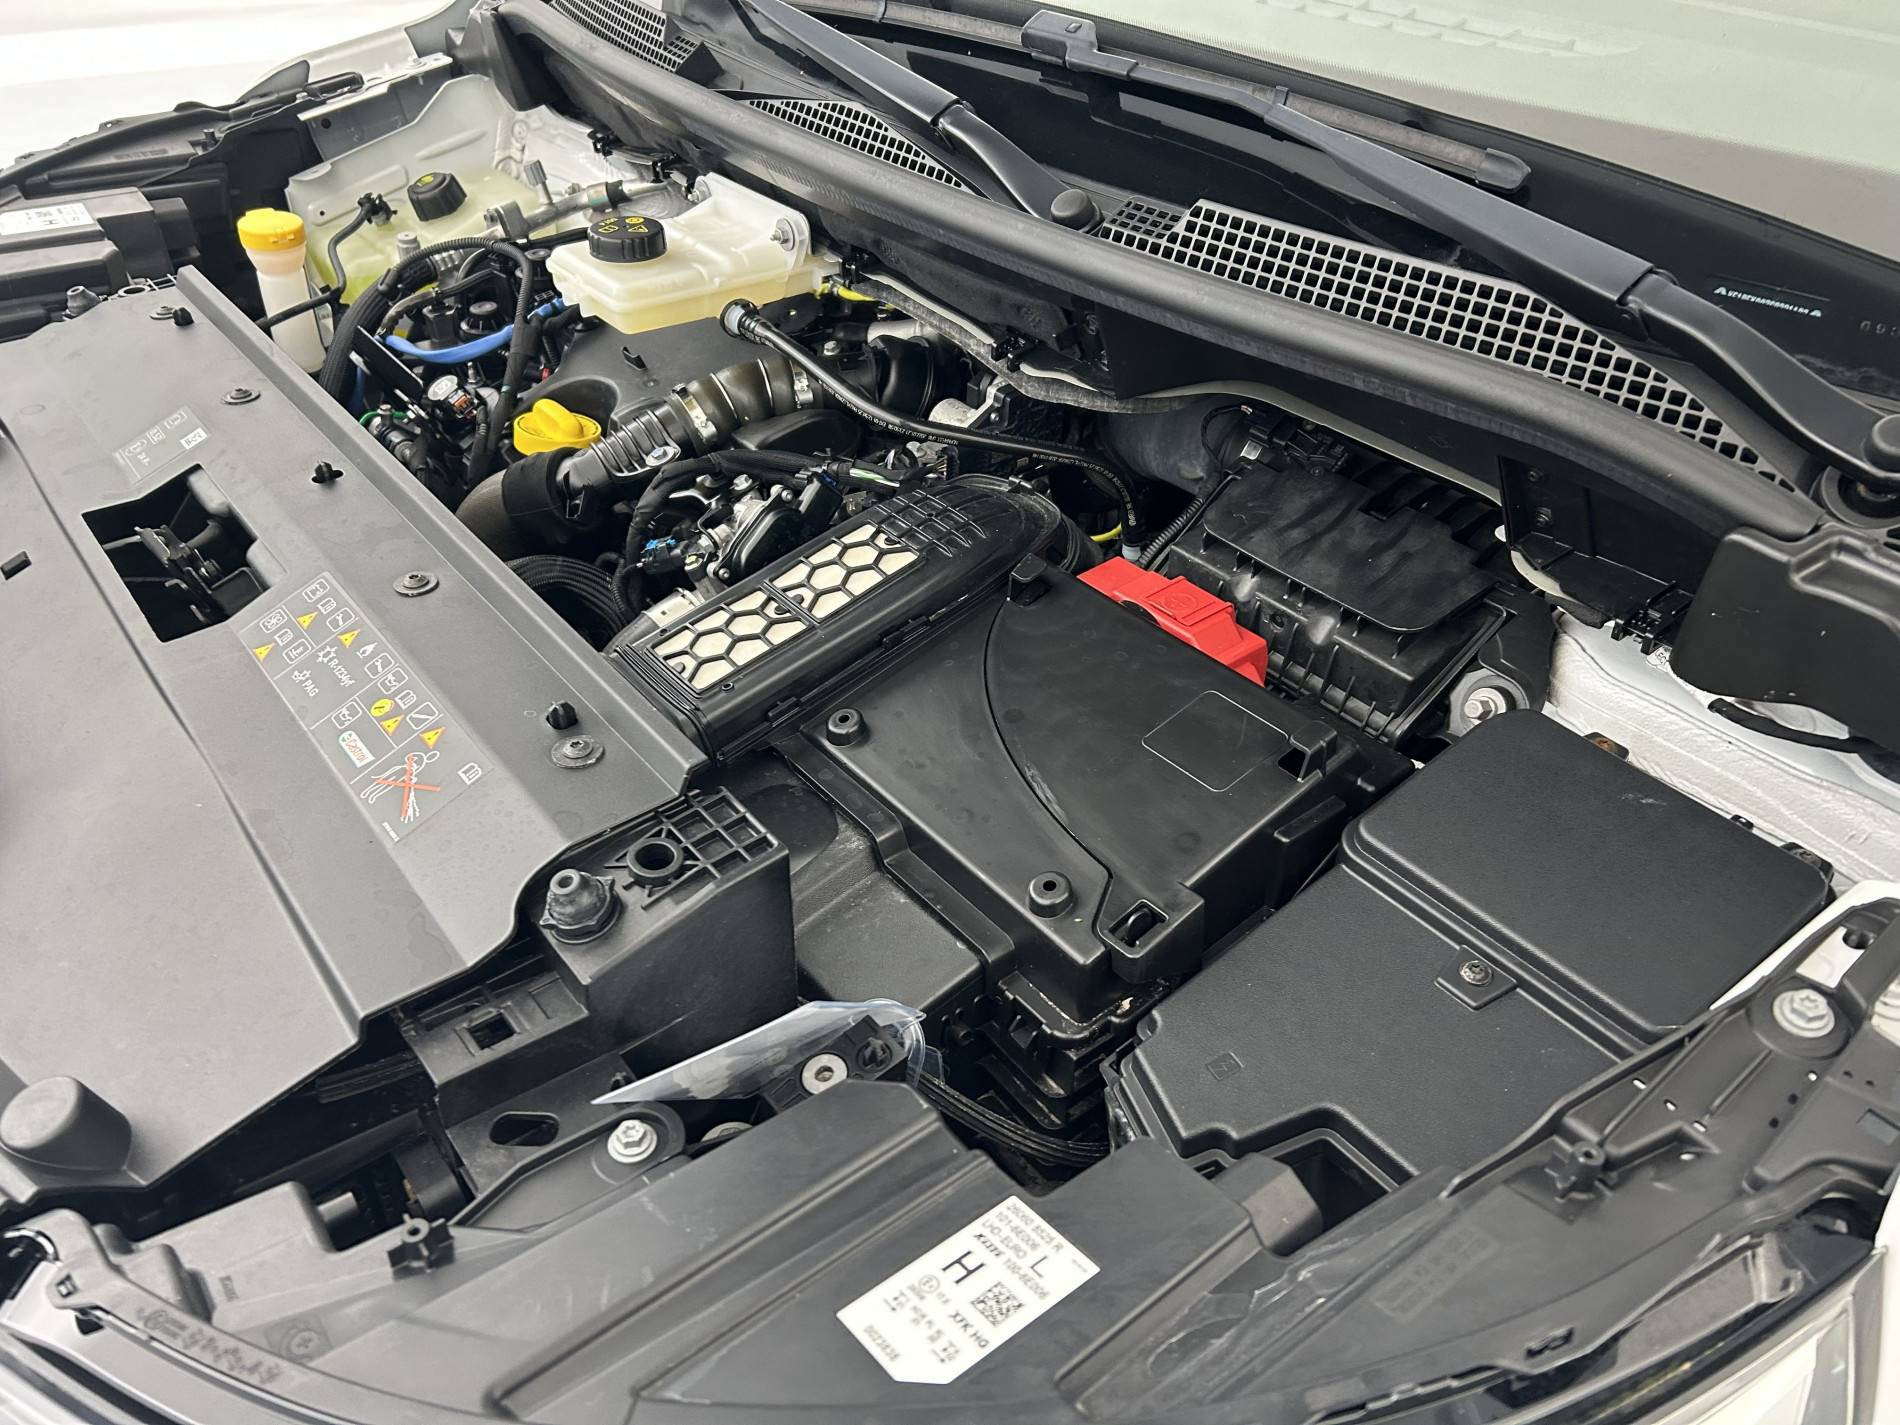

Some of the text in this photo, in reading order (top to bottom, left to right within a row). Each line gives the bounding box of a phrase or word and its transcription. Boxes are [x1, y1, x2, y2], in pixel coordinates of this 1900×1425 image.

[302, 680, 319, 697] PAG
[942, 1251, 985, 1284] H
[1030, 1255, 1048, 1278] L
